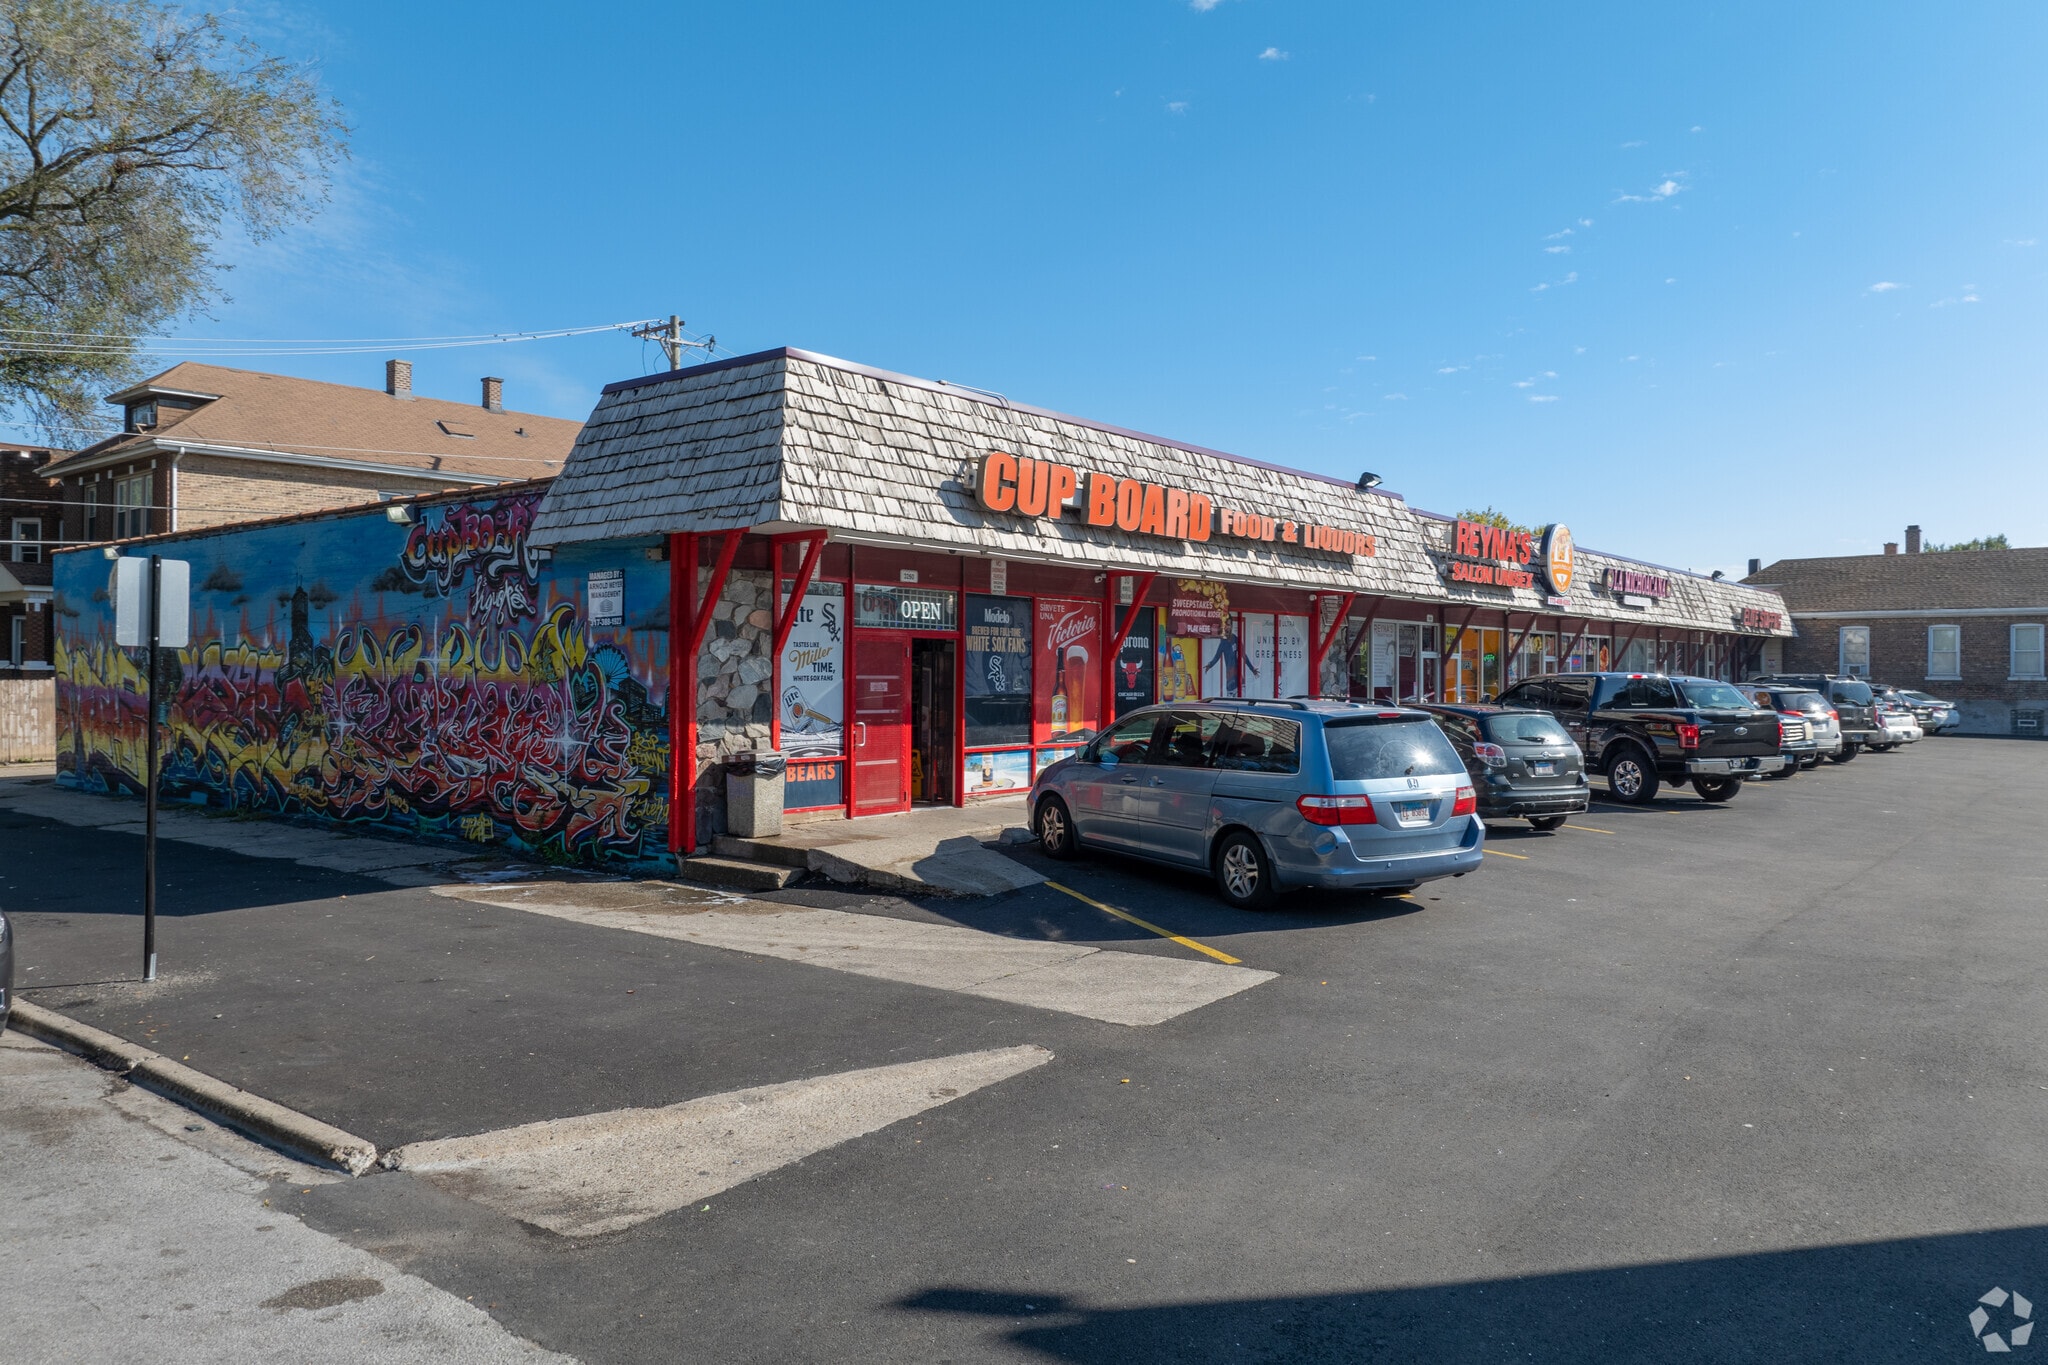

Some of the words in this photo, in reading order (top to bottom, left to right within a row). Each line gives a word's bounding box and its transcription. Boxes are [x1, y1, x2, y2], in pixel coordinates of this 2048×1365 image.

[981, 452, 1077, 520] CUP
[1087, 472, 1212, 542] BOARD
[1221, 508, 1275, 542] FOOD
[1282, 522, 1298, 543] &
[1304, 523, 1376, 557] LIQUORS
[1455, 521, 1532, 565] REYNA'S
[589, 571, 613, 580] MANAGED
[1452, 562, 1493, 585] SALON
[1495, 567, 1534, 589] UNISEX
[589, 582, 608, 590] ARNOLD
[590, 590, 621, 599] MANAGEMENT
[901, 600, 942, 620] OPEN
[1172, 599, 1213, 609] SWEEPSTAKES
[984, 608, 1010, 624] Modelo
[1039, 611, 1055, 621] UNA
[1171, 609, 1207, 617] PROMOTIONAL
[990, 626, 999, 636] FOR
[1047, 606, 1096, 650] Victoria
[1187, 624, 1198, 632] PLAY
[966, 635, 990, 652] WHITE
[991, 637, 1007, 653] SOX
[1008, 637, 1026, 653] FANS
[1292, 637, 1300, 646] BY
[788, 646, 833, 672] Miller
[812, 662, 836, 674] TIME,
[786, 763, 836, 783] BEARS
